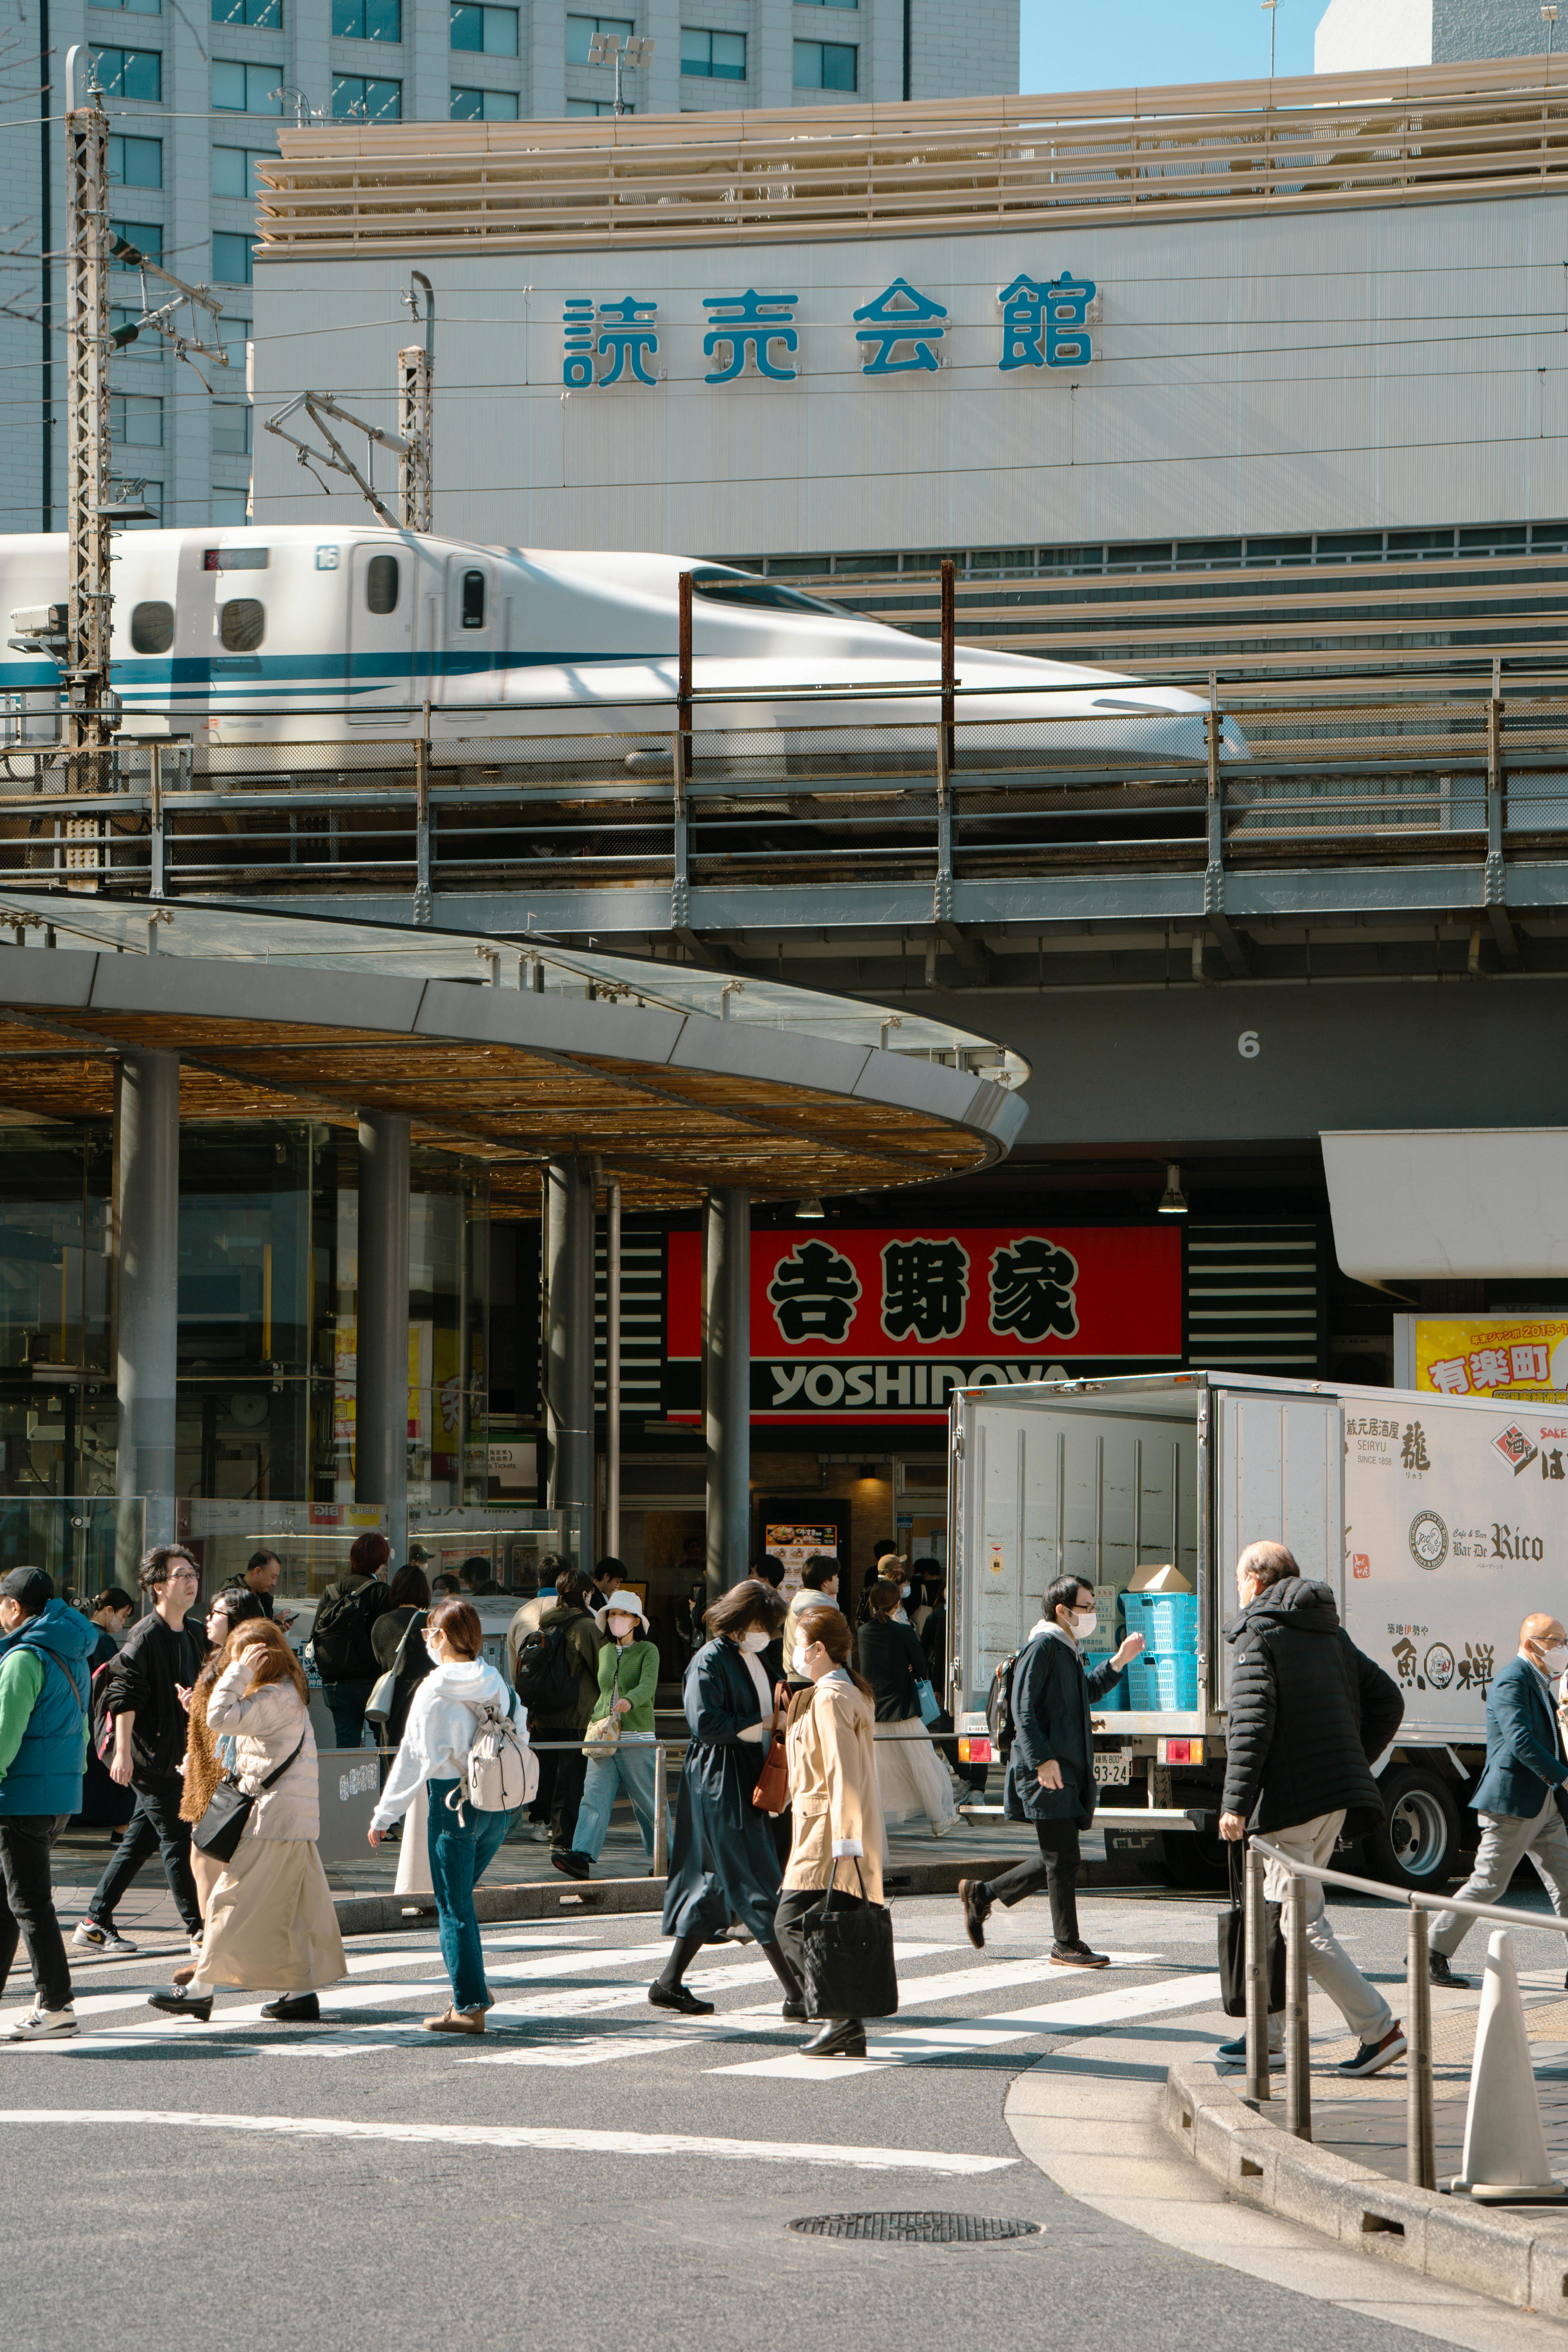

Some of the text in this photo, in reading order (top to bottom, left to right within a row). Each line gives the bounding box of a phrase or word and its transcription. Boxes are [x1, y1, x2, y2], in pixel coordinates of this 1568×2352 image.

[563, 272, 1095, 388] 読売会館
[318, 547, 338, 569] 16
[1238, 1031, 1260, 1058] 6
[1470, 1329, 1521, 1345] 年末ジャンボ
[1428, 1343, 1550, 1395] 有楽町
[1347, 1418, 1399, 1439] 蔵元居酒屋
[1540, 1427, 1568, 1440] SAKE
[1357, 1439, 1386, 1452] SEIRYU
[1400, 1420, 1431, 1470] 龍
[1358, 1455, 1392, 1465] SINCE 1858
[1541, 1448, 1568, 1481] は
[1411, 1515, 1426, 1544] EUROPEAN
[1453, 1529, 1466, 1539] Cafe
[1475, 1530, 1487, 1538] Beer
[1453, 1542, 1487, 1558] Bar De
[1490, 1523, 1543, 1562] Rico
[1387, 1623, 1428, 1636] 築地伊勢や
[1095, 1755, 1120, 1763] 練馬 800
[1094, 1765, 1126, 1782] 93-24
